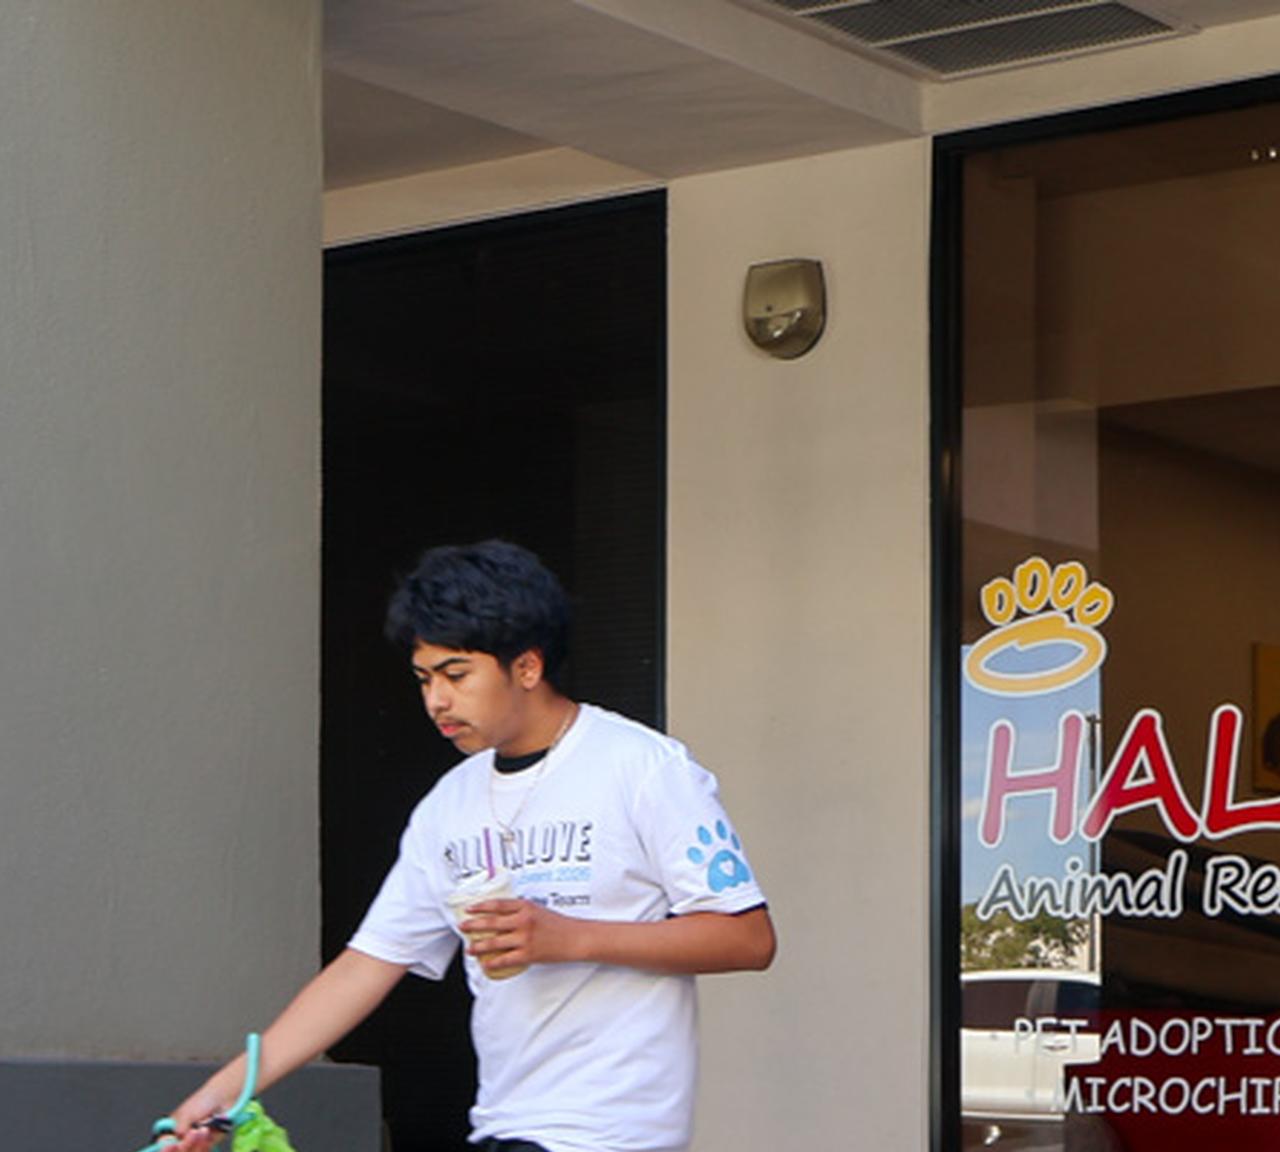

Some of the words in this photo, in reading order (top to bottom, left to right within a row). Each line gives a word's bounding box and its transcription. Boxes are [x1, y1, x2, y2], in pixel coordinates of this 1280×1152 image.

[524, 819, 594, 864] LOVE
[977, 849, 1188, 922] Animal
[1014, 1017, 1089, 1054] PET
